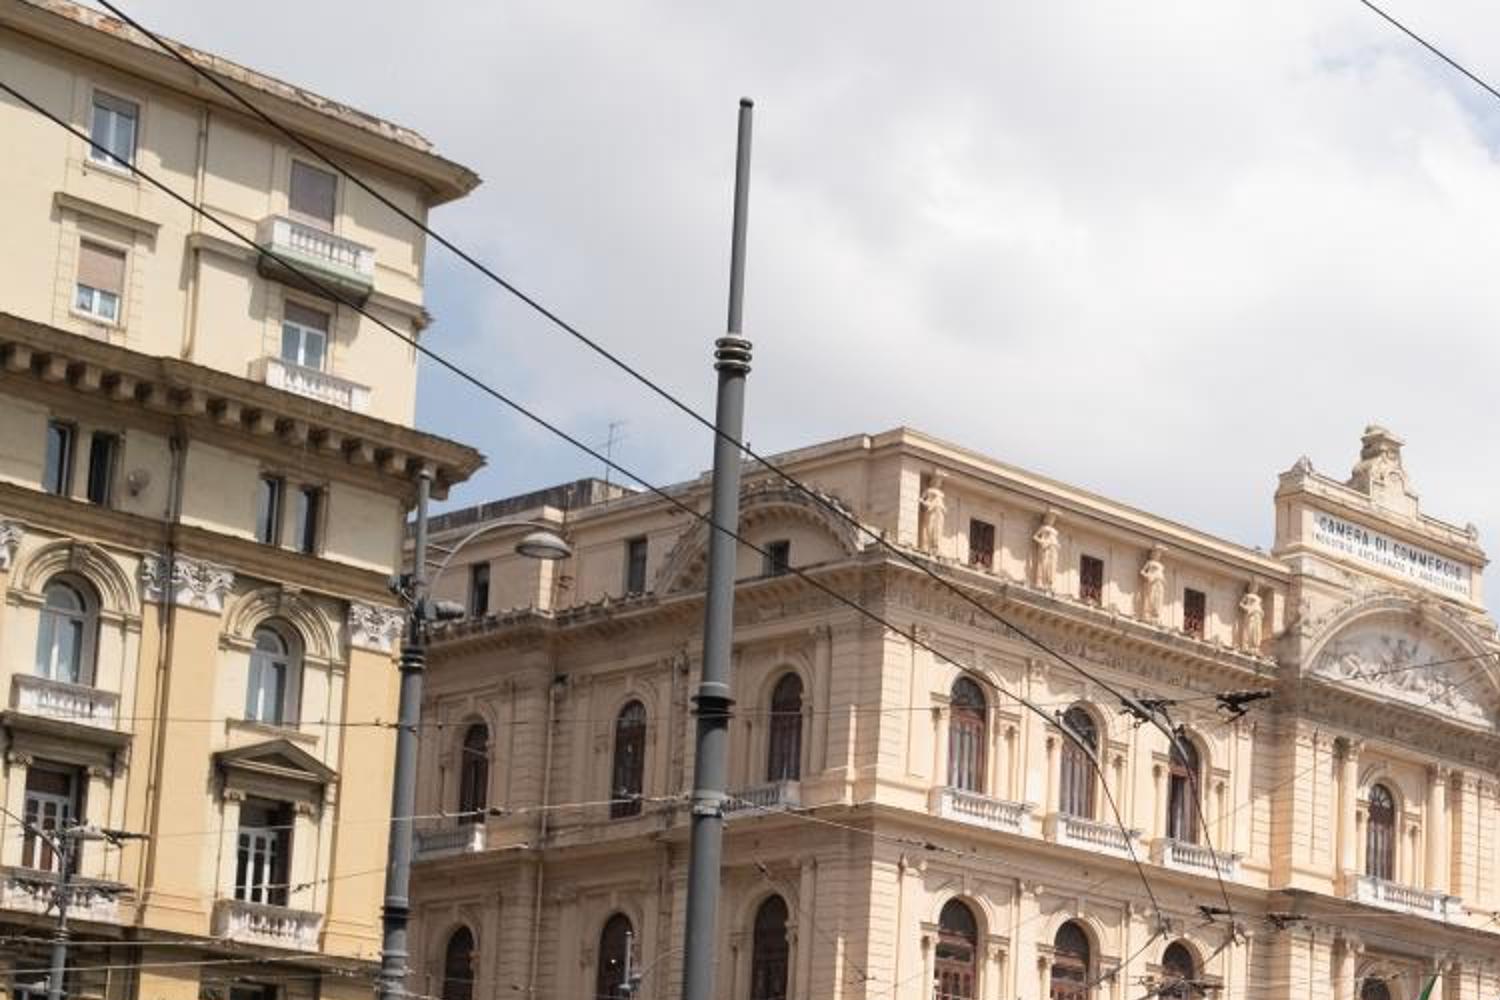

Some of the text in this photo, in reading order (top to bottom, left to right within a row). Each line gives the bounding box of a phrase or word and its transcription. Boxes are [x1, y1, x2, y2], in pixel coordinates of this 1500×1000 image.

[1319, 516, 1461, 579] CAMERA DI COMMERCIO
